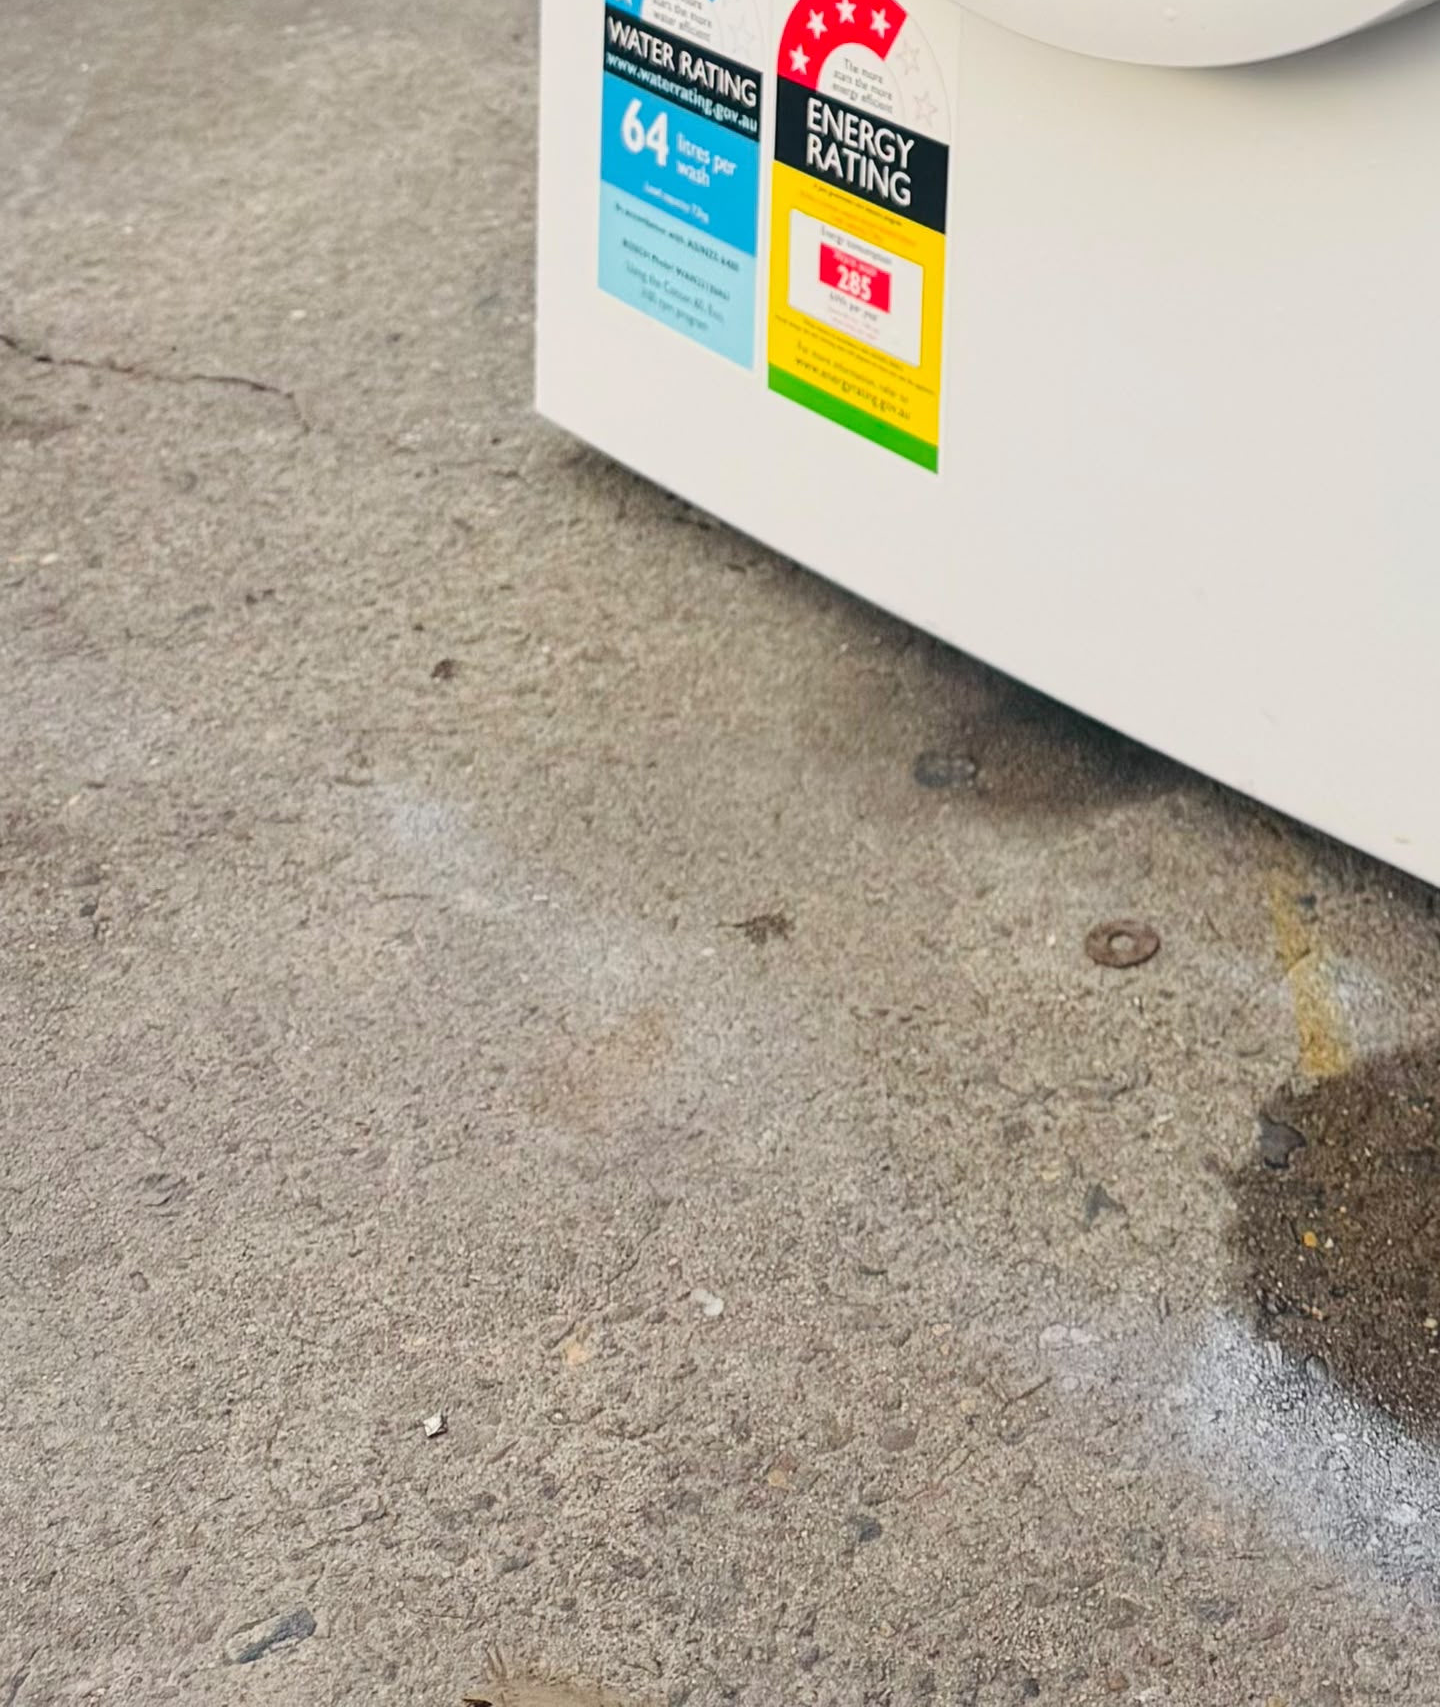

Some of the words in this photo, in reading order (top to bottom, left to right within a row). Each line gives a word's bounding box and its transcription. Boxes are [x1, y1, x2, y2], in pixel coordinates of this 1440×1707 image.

[606, 51, 758, 132] www.waterrating.gov.au
[607, 15, 676, 72] WATER
[678, 49, 757, 108] RATING
[621, 98, 669, 168] 64
[676, 132, 711, 166] litres
[712, 154, 737, 177] per
[806, 96, 915, 170] ENERGY
[676, 160, 711, 188] wash
[806, 133, 912, 207] RATING
[837, 264, 873, 302] 285
